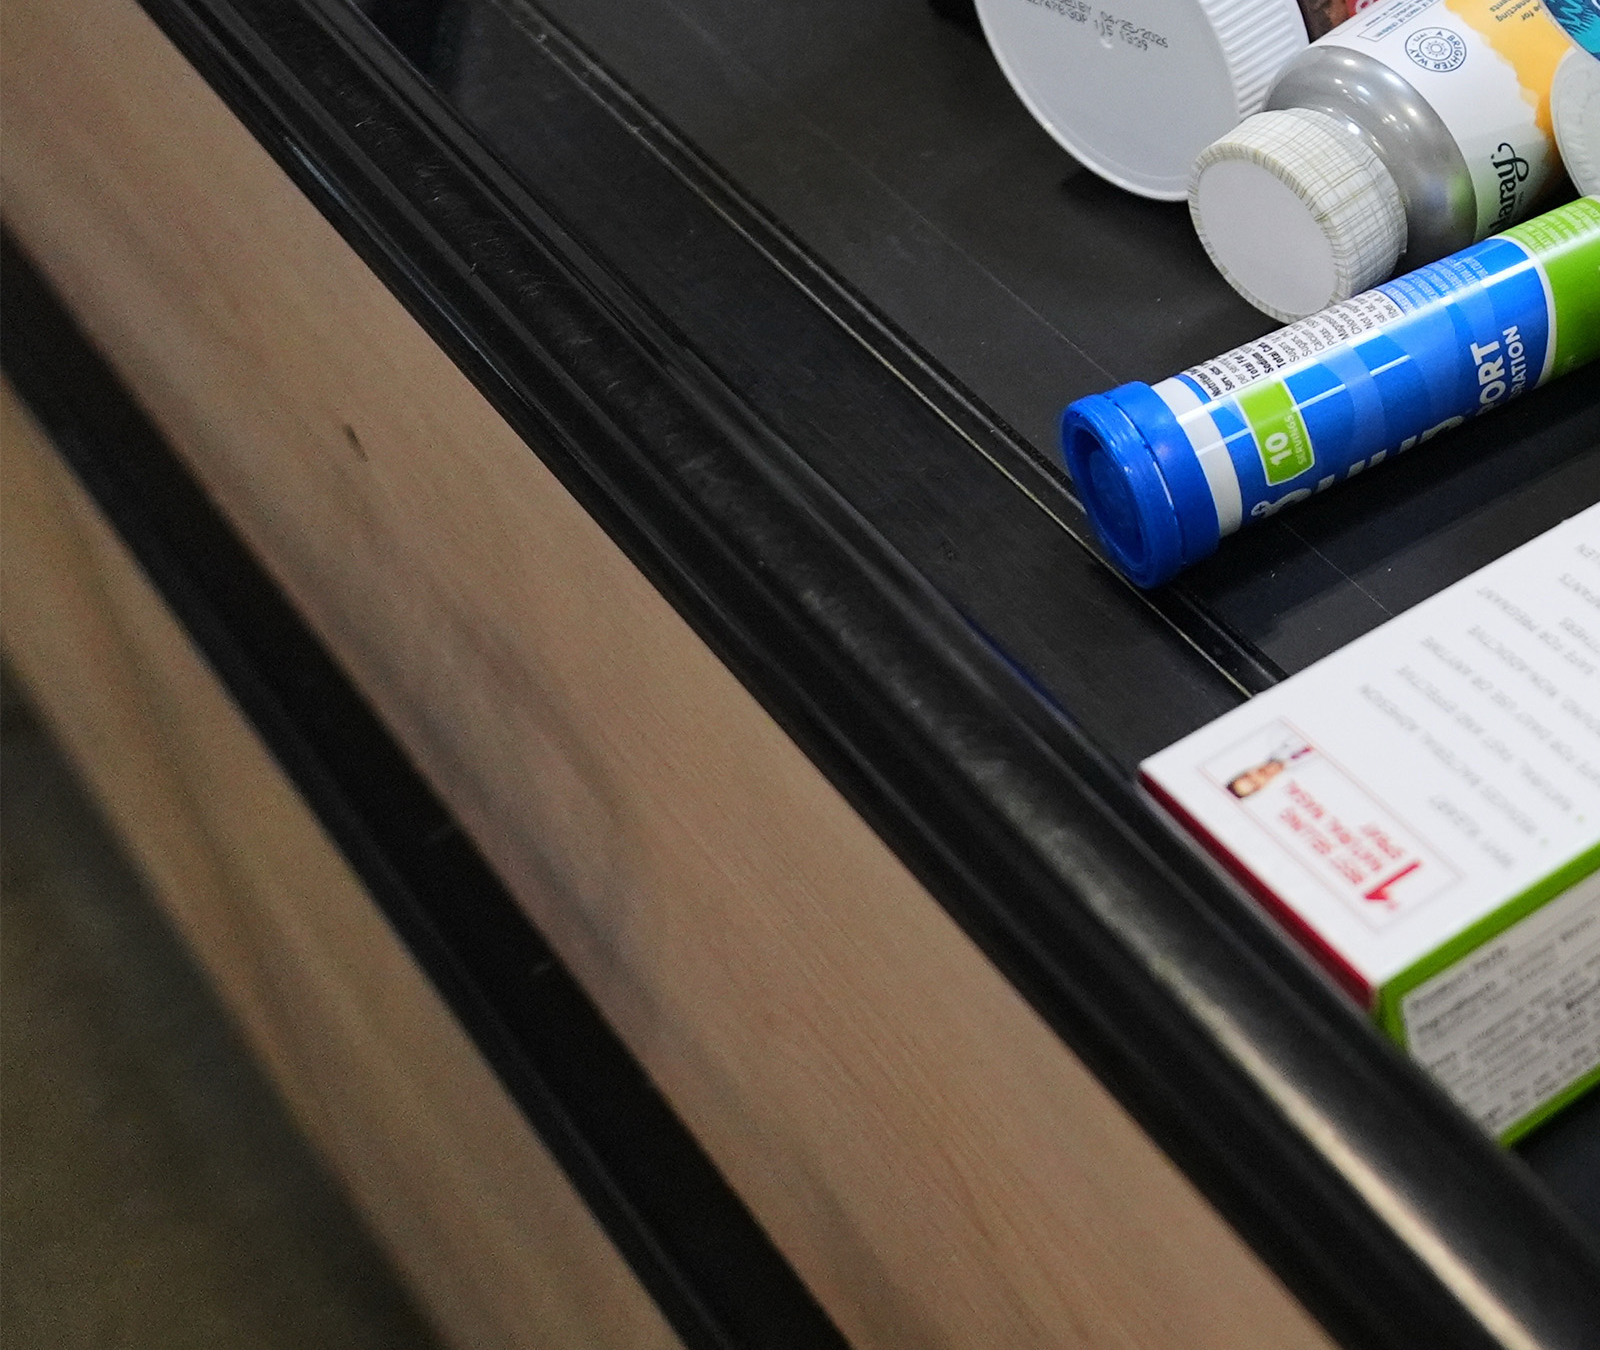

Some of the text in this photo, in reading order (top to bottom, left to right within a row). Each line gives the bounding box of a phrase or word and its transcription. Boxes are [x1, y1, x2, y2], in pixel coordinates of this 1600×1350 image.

[1409, 48, 1428, 67] WAY
[1433, 35, 1464, 70] BRIGHTER
[1265, 431, 1290, 466] 10
